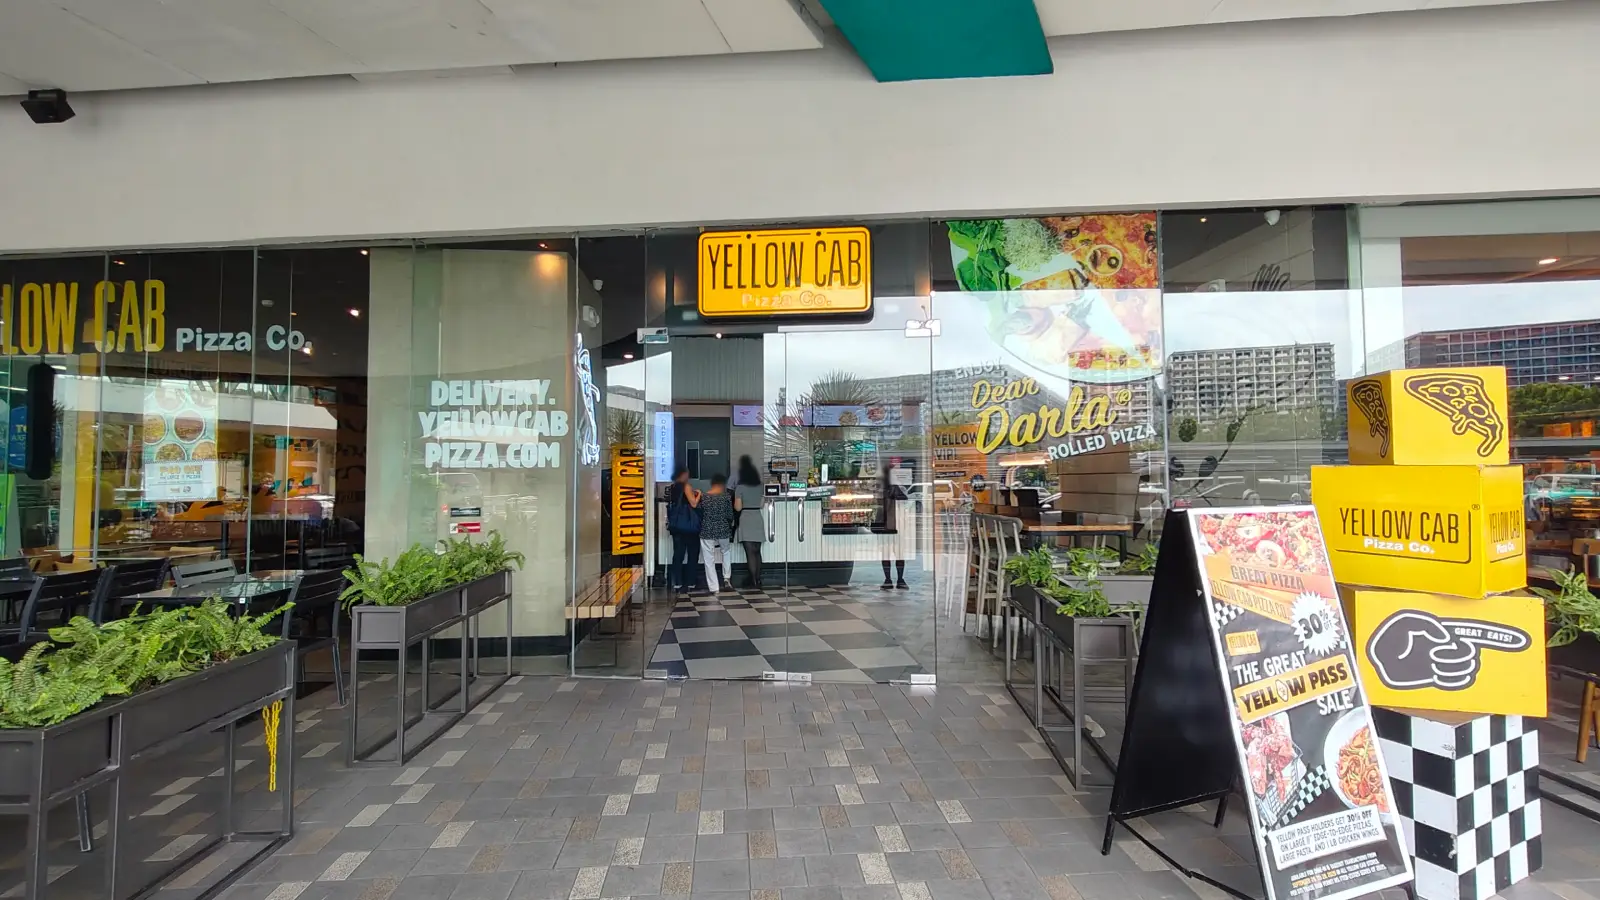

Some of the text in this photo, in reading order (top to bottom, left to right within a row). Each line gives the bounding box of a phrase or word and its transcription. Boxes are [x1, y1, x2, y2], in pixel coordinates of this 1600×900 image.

[708, 239, 862, 290] YELLOW CAB
[742, 291, 832, 308] Pizza Co.
[3, 279, 165, 355] LOW CAB
[176, 325, 312, 352] Pizza Co.
[431, 380, 556, 406] DELIVERY.
[972, 376, 1039, 408] Dear
[418, 411, 568, 438] YELLOWCAB
[976, 386, 1117, 454] Darla
[934, 432, 978, 446] YELLOW
[1048, 424, 1158, 461] ROLLED PIZZA
[424, 442, 560, 468] PIZZA.COM
[1340, 508, 1458, 544] YELLOW CAB
[1489, 510, 1520, 544] YELLOW CAB
[1364, 538, 1435, 554] Pizza Co.
[1496, 544, 1508, 554] Pizza
[1230, 565, 1268, 585] GREAT
[1454, 628, 1513, 642] GREAT EATS!
[1234, 650, 1306, 685] THE GREAT
[1308, 662, 1348, 690] PASS
[1316, 690, 1354, 716] SALE
[1276, 810, 1372, 842] YELLOW PASS HOLDERS GET 30% OFF
[1280, 844, 1289, 852] ON
[1289, 838, 1306, 850] LARGE
[1314, 826, 1354, 840] EDGE-TO-EDGE
[1280, 852, 1296, 864] LARGE
[1314, 842, 1326, 852] AND
[1330, 838, 1338, 847] LB
[1337, 833, 1360, 845] CHICKEN
[1362, 828, 1380, 838] WINGS
